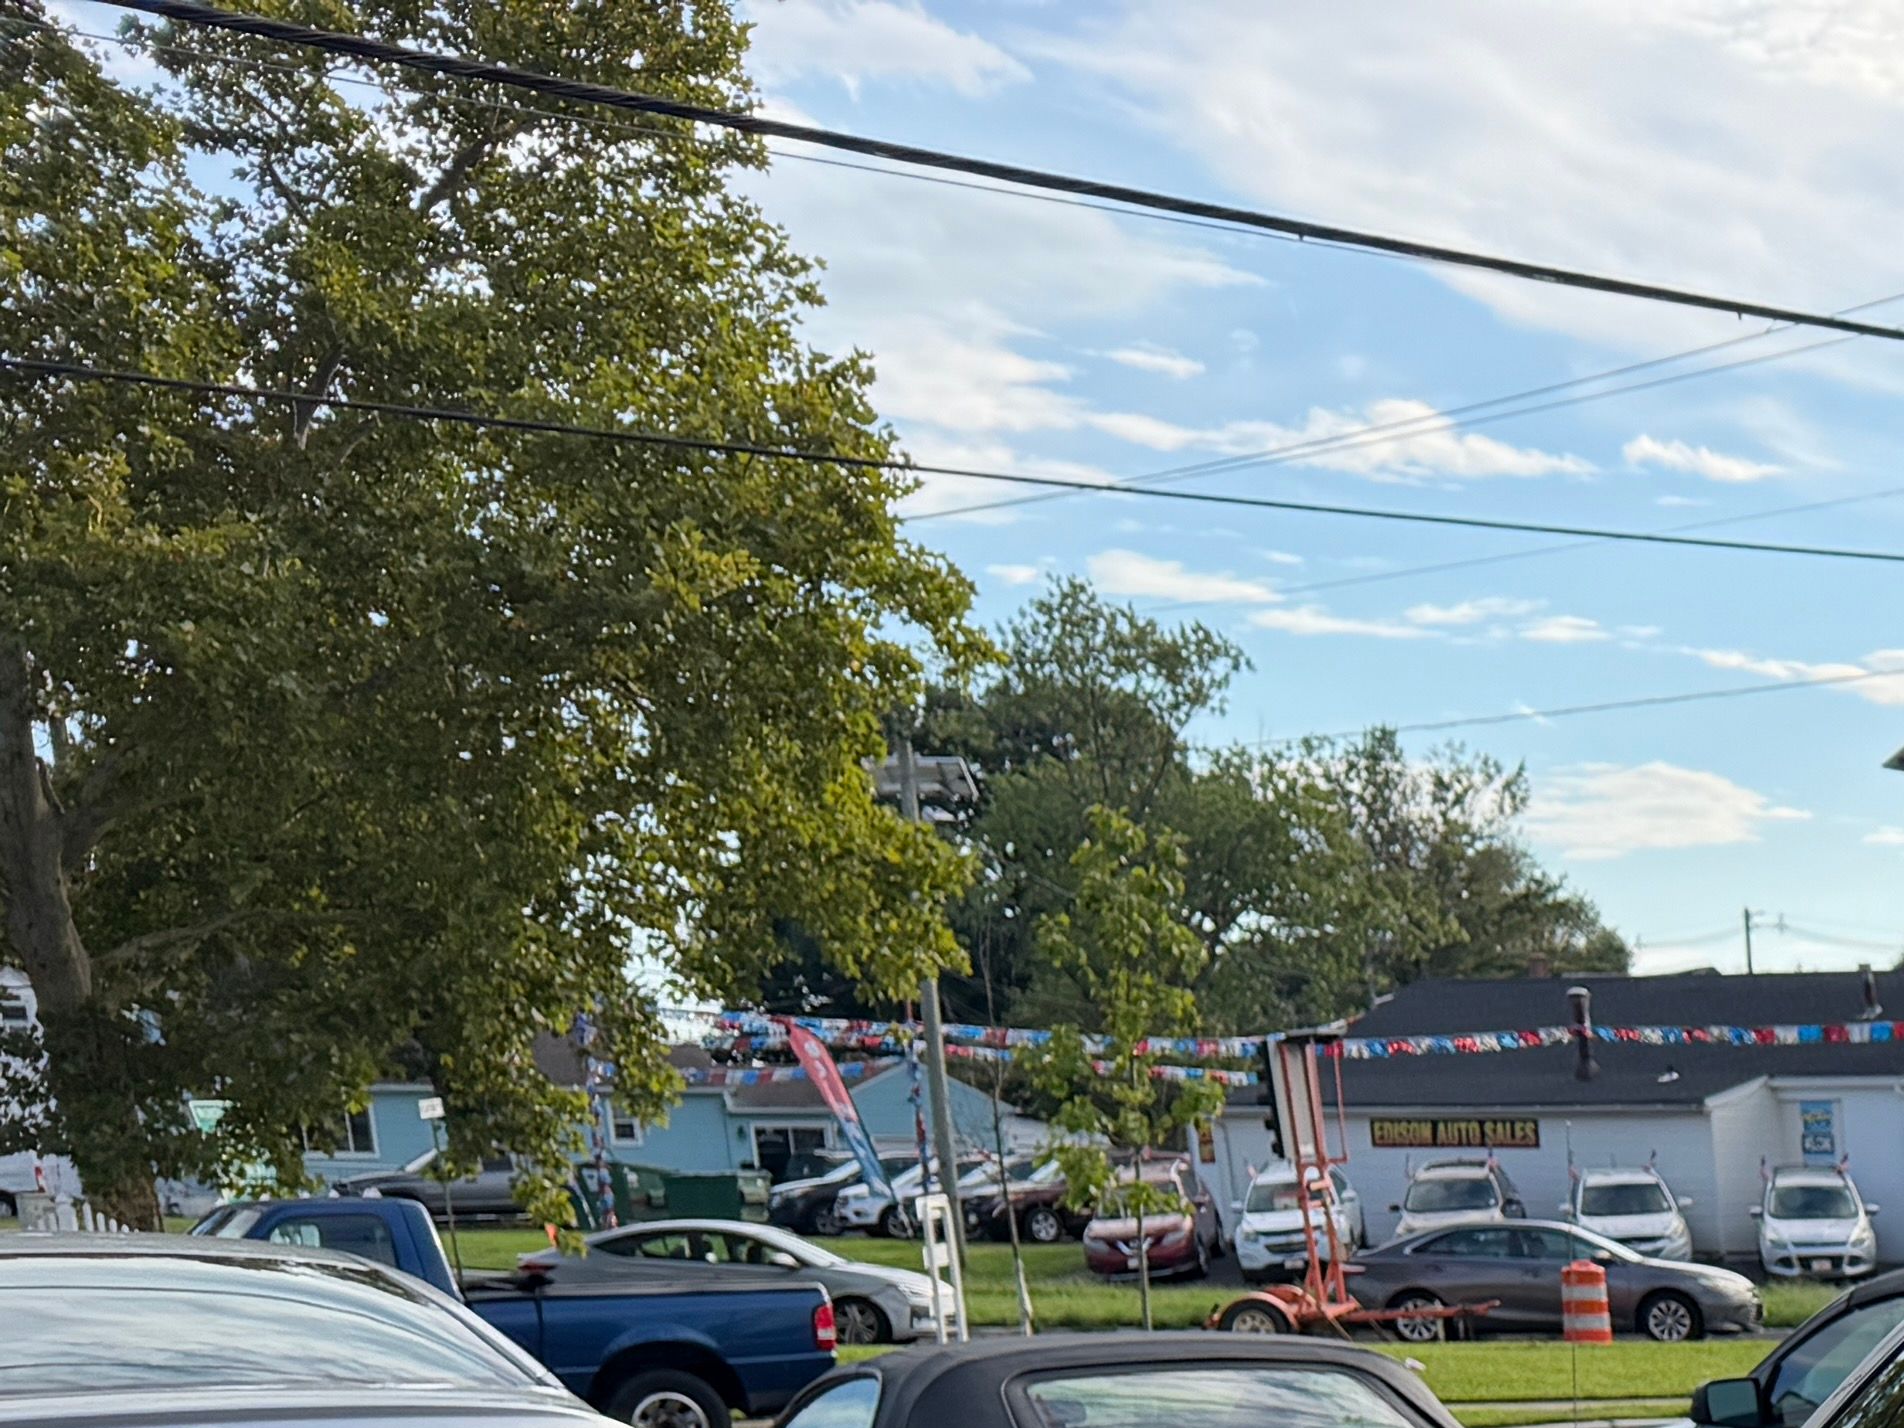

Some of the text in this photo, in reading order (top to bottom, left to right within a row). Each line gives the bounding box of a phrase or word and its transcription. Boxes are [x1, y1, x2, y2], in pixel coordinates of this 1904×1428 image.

[1374, 1120, 1536, 1145] EDISON AUTO SALES
